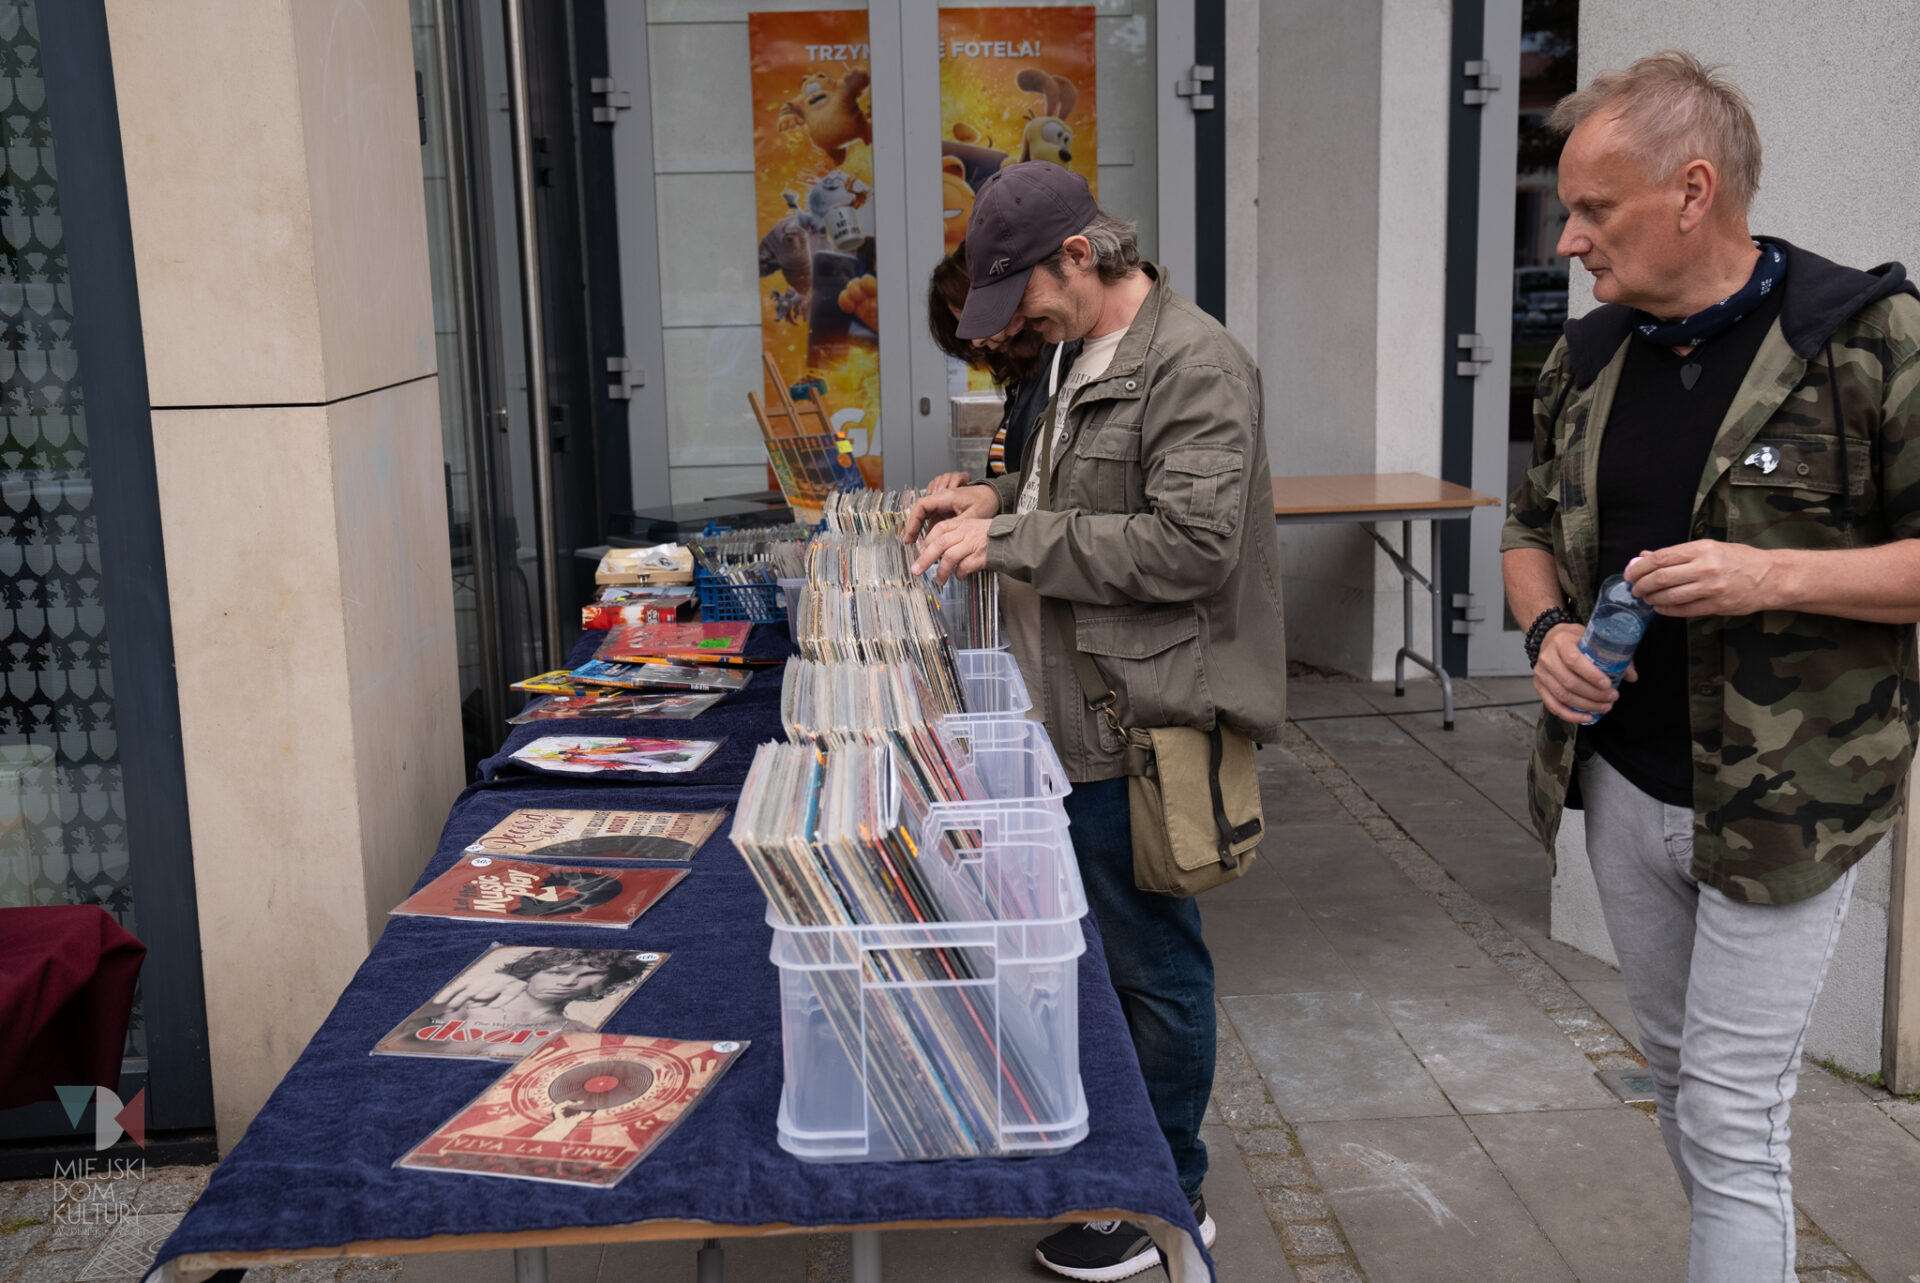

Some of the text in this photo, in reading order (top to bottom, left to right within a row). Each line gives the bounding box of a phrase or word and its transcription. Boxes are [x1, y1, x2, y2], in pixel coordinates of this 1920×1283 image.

[952, 40, 1041, 58] FOTELA!
[471, 875, 514, 913] Music
[454, 1137, 616, 1159] VIVA LA VINYL
